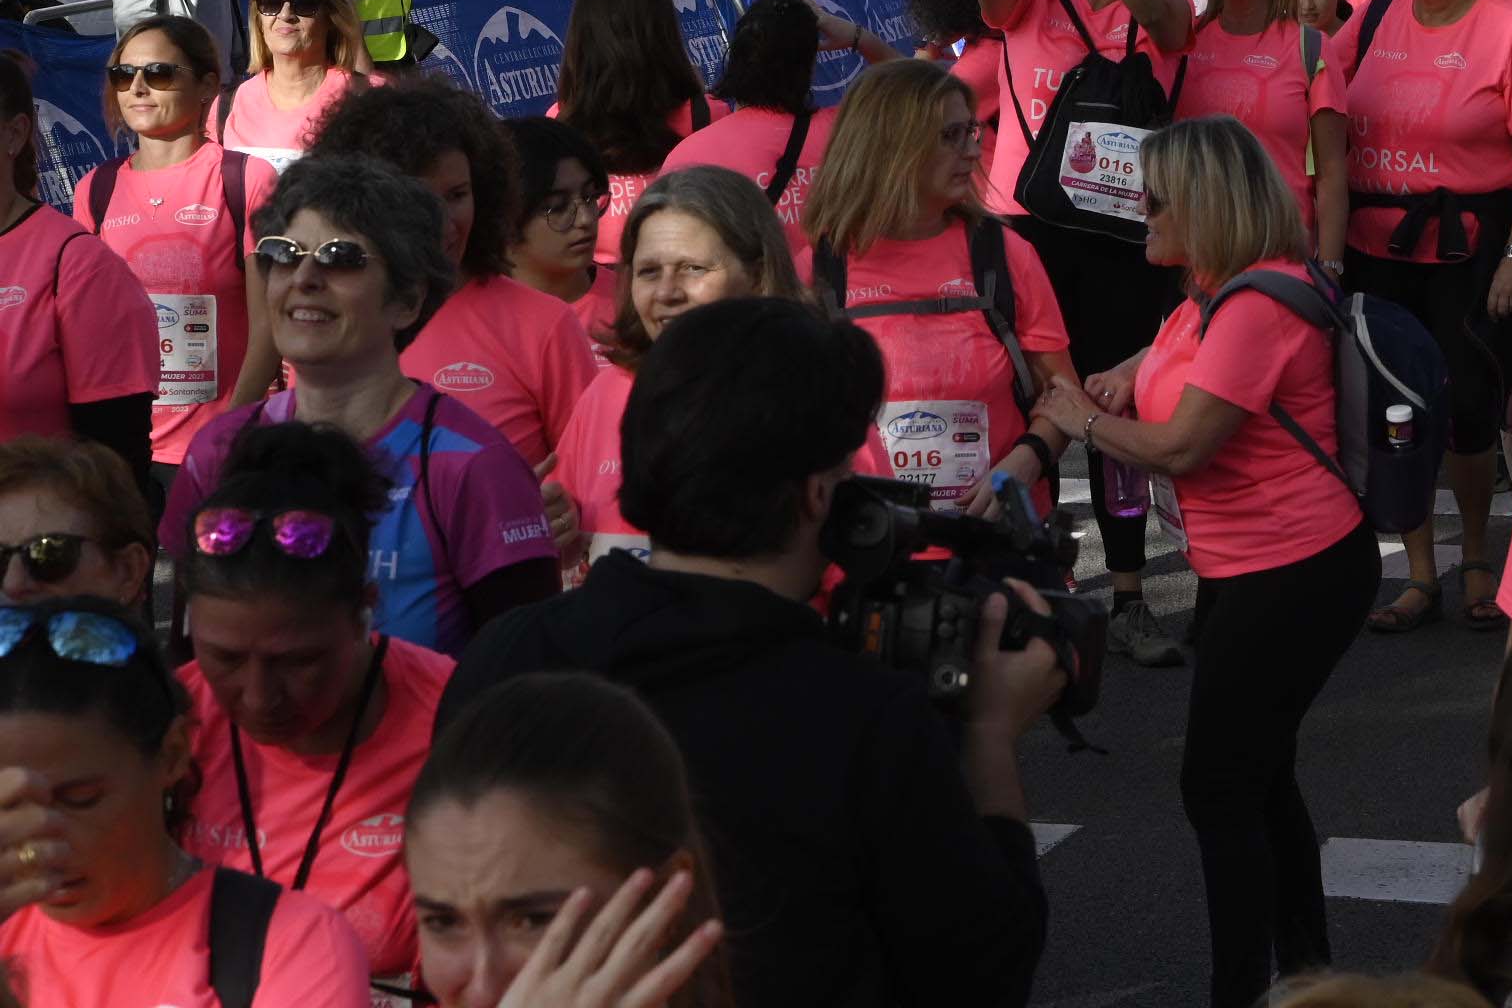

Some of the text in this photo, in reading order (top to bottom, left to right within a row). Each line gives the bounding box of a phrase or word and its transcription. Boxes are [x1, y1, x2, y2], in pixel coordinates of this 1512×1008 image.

[1373, 49, 1408, 61] OYSHO
[1032, 68, 1064, 91] TU
[1100, 137, 1140, 151] ASTURIANA
[1098, 156, 1134, 175] 016
[1099, 173, 1128, 187] 23816
[611, 180, 636, 199] DE
[1071, 179, 1099, 191] CARRERA
[1118, 190, 1139, 199] MUJER
[1072, 193, 1097, 205] YSHO
[437, 370, 493, 387] ASTURIANA
[168, 387, 209, 397] Santander
[952, 416, 979, 424] SUMA
[891, 421, 943, 434] ASTURIANA
[893, 449, 942, 469] 016
[898, 472, 937, 485] 22177
